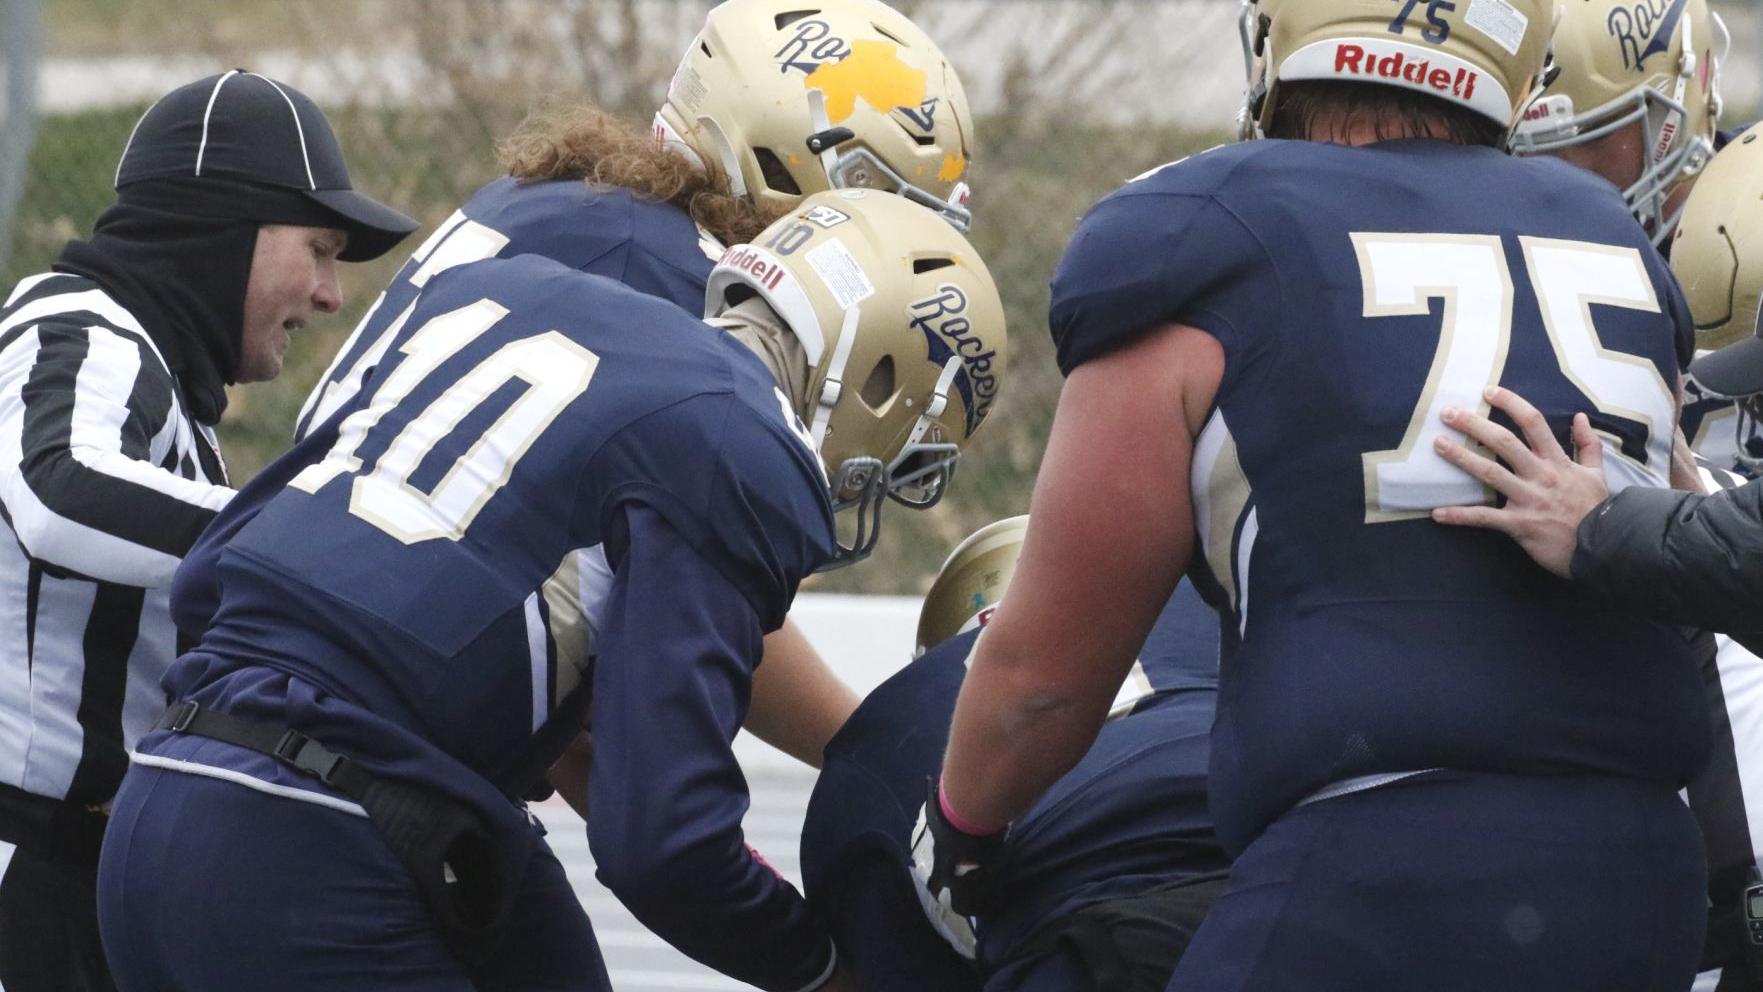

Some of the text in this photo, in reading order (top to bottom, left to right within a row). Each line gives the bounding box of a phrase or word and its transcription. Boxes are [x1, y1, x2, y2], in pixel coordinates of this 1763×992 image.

[1335, 44, 1478, 100] Riddell
[766, 222, 814, 256] 10
[287, 298, 600, 545] 10
[1349, 232, 1675, 524] 75
